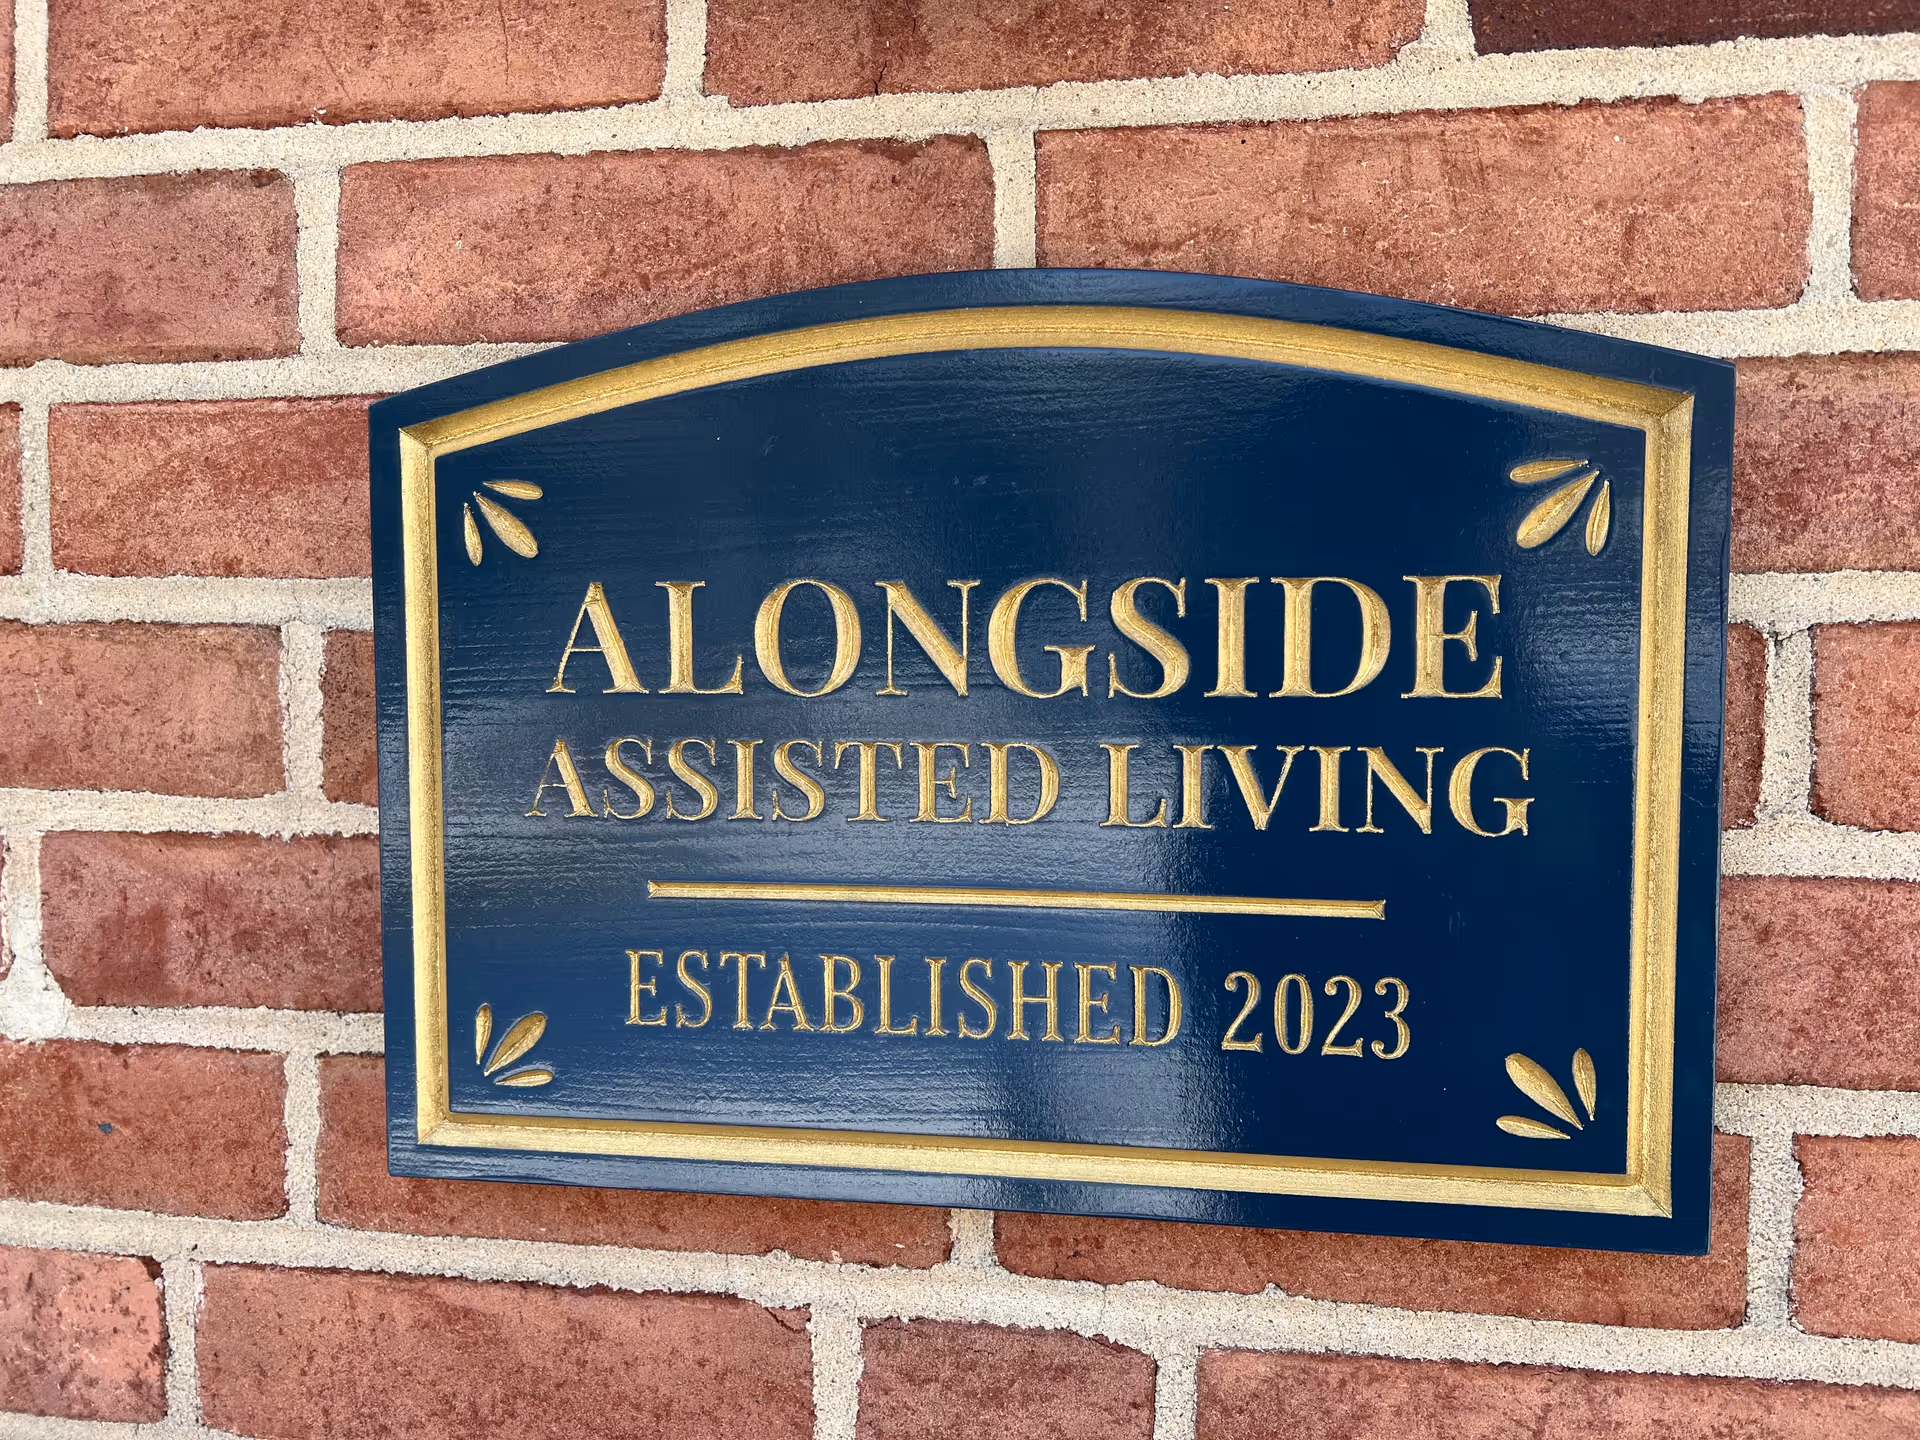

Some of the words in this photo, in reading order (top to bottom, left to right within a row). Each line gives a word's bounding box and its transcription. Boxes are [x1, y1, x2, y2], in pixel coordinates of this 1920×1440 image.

[546, 575, 1502, 699] ALONGSIDE
[525, 738, 1060, 826] ASSISTED
[1100, 743, 1535, 837] LIVING
[625, 949, 1182, 1048] ESTABLISHED
[1221, 971, 1411, 1060] 2023
